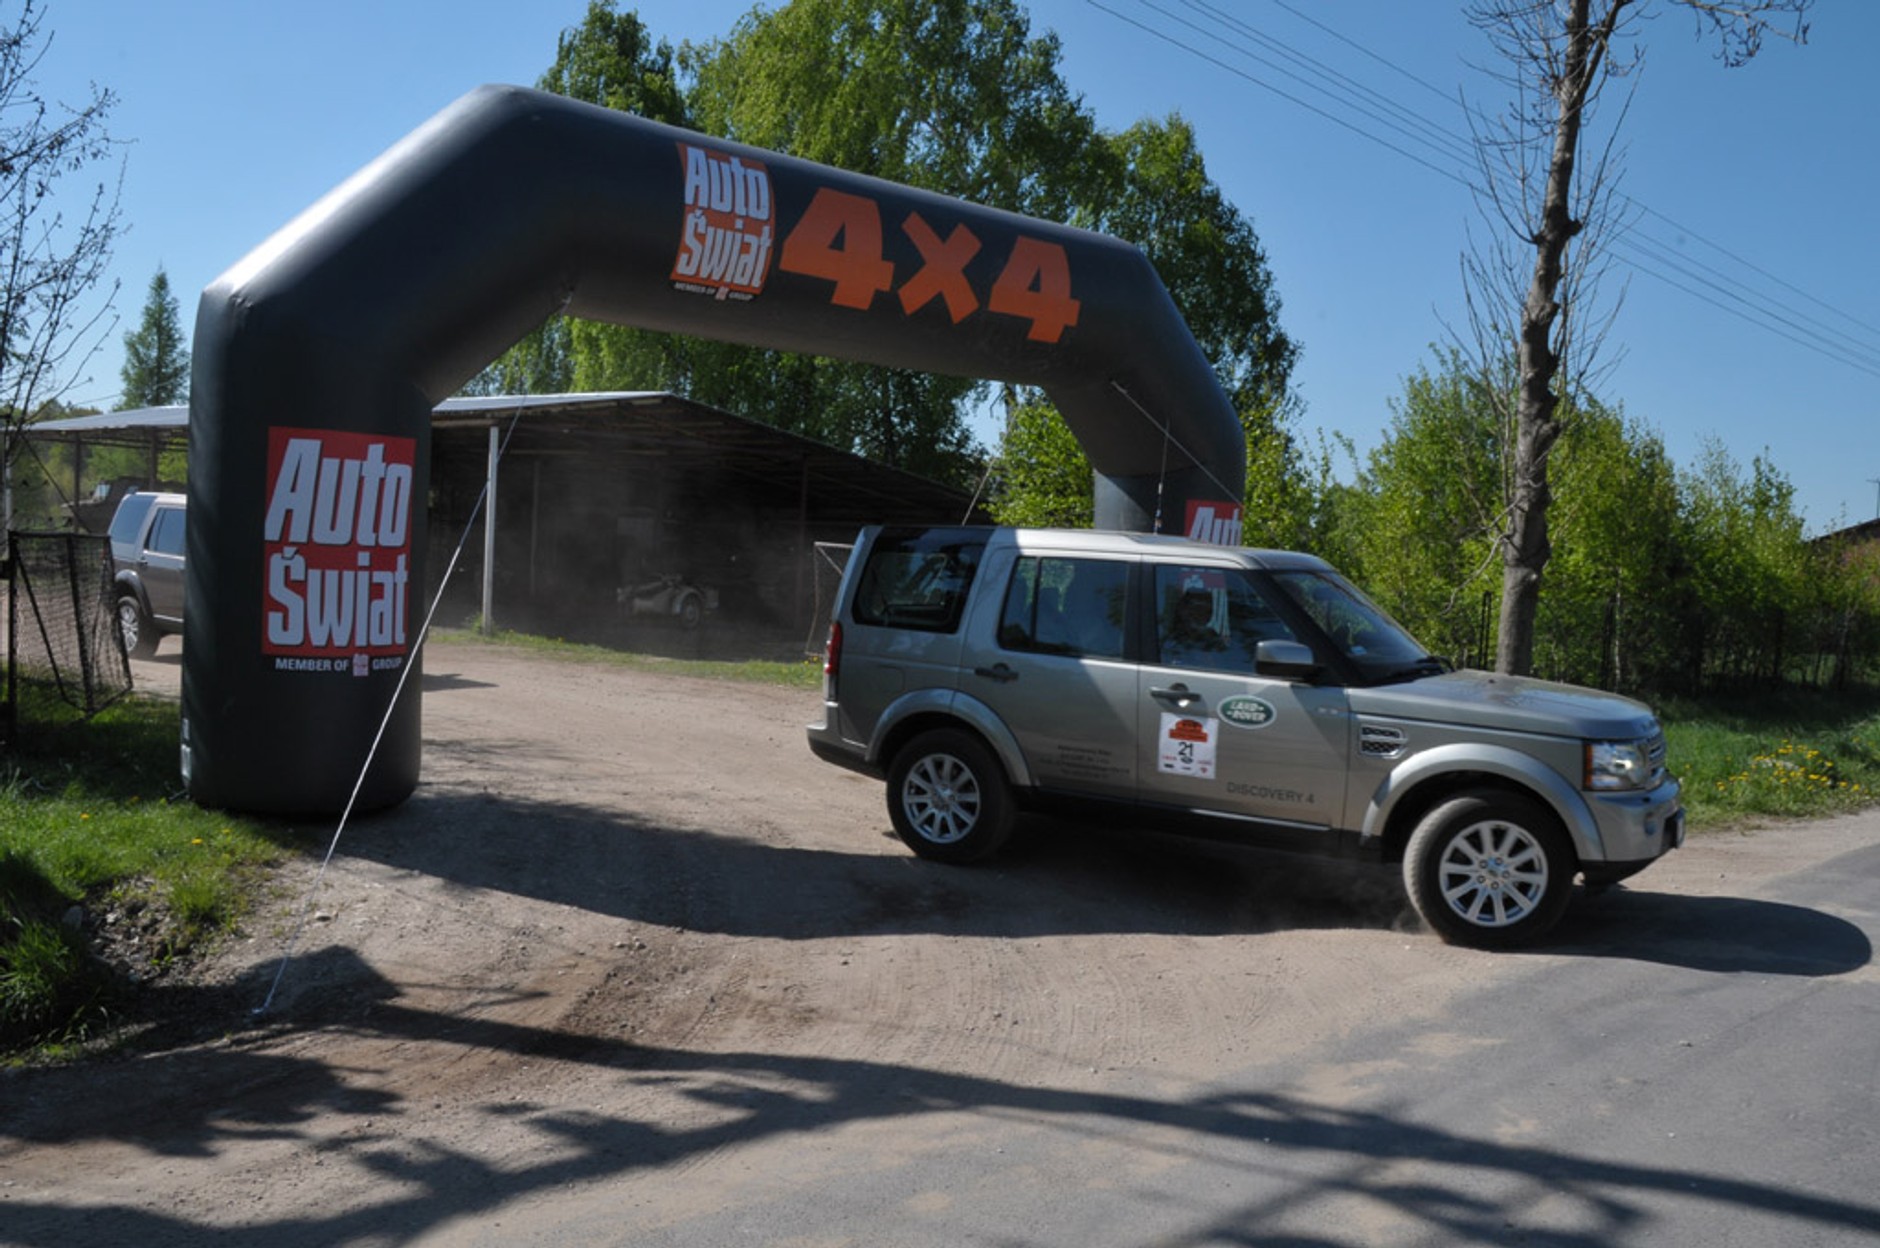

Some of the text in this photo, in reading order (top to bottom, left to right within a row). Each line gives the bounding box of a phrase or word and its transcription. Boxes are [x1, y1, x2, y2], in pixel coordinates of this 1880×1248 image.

[684, 146, 770, 220] Auto
[676, 208, 772, 287] Świat
[264, 438, 413, 546] Auto
[267, 547, 409, 647] Świat
[275, 657, 332, 672] MEMBER
[333, 658, 350, 671] OF
[372, 657, 403, 670] GROUP
[1177, 741, 1194, 757] 21
[1226, 781, 1315, 804] DISCOVERY 4
